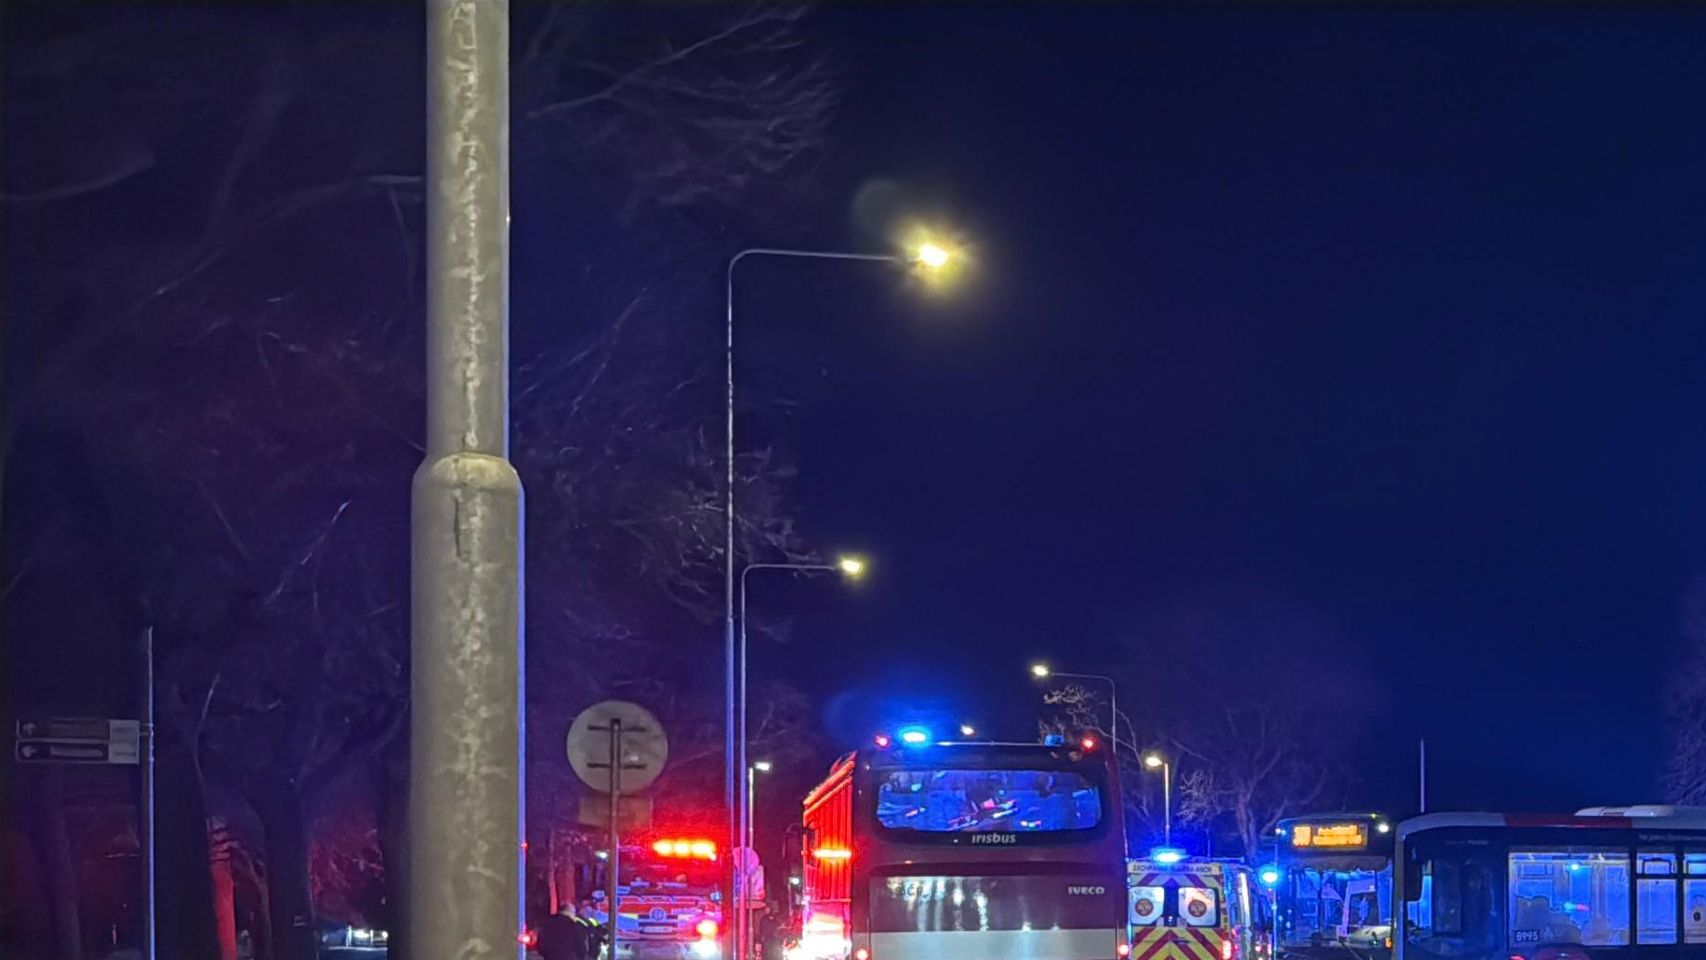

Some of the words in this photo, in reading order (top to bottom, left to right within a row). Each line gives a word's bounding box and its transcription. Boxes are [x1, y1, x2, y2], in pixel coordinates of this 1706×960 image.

[971, 832, 1016, 844] irisbus
[1068, 886, 1105, 895] IVECO
[1516, 931, 1538, 942] 8995
